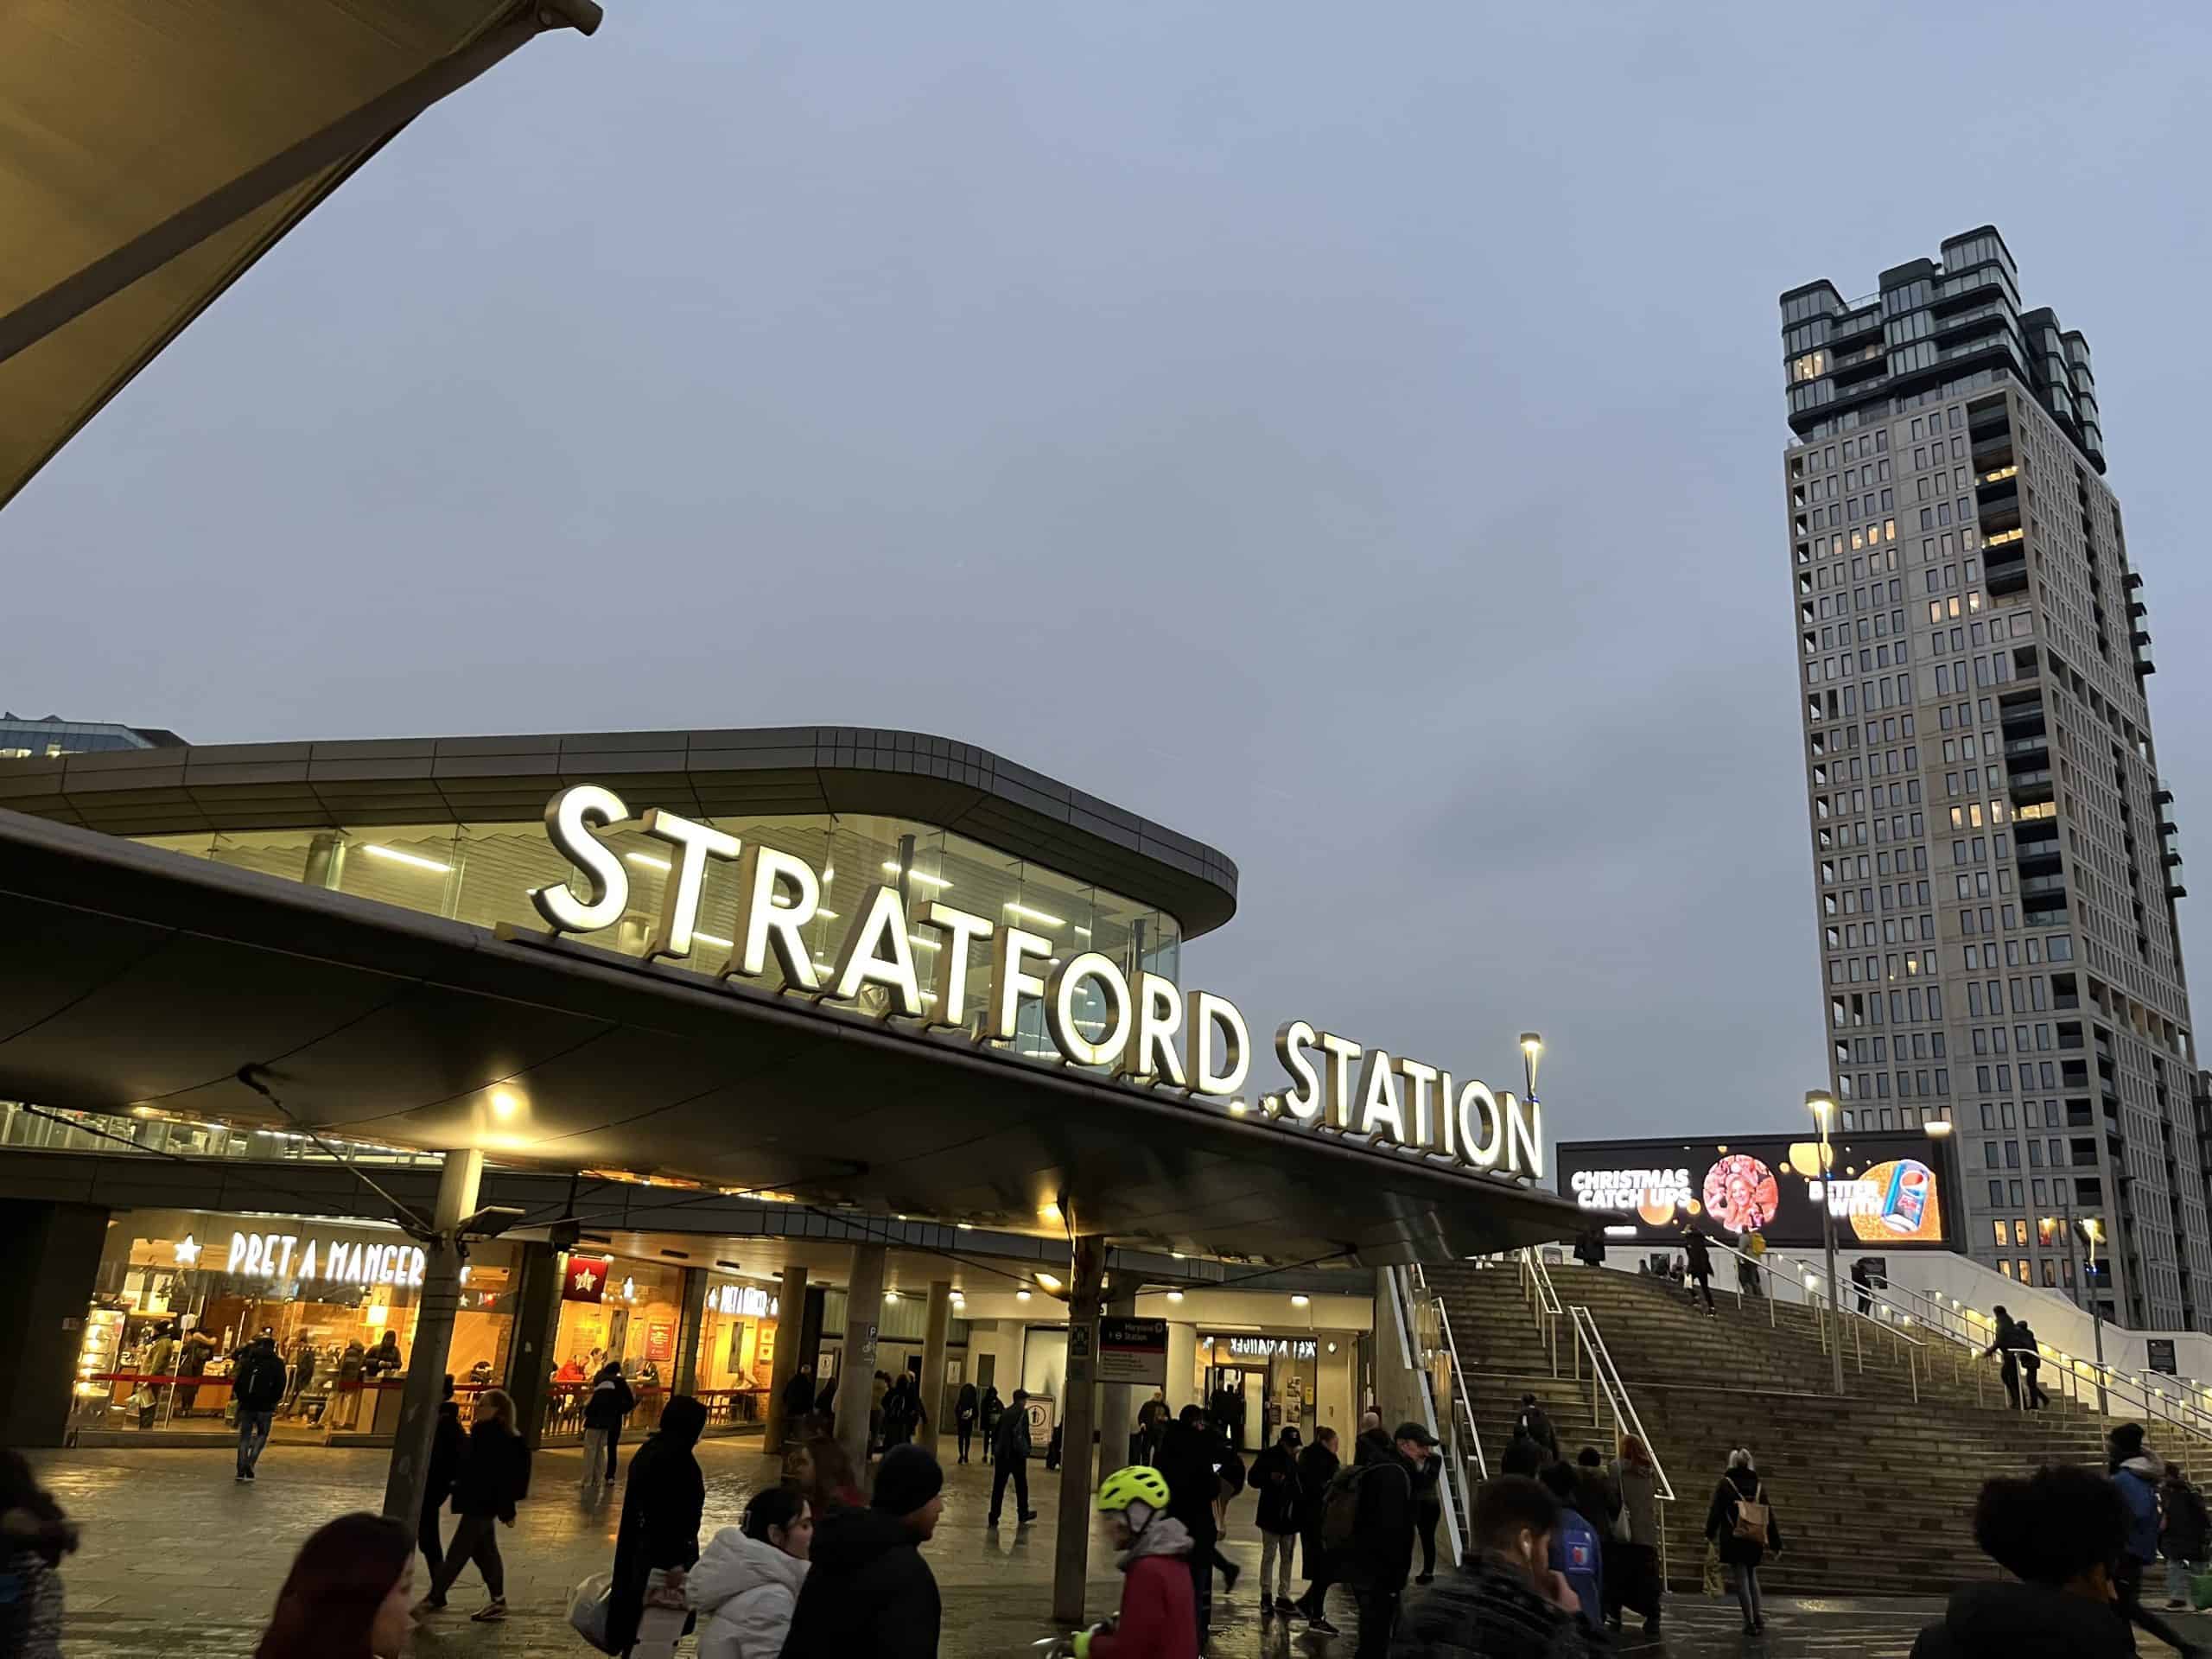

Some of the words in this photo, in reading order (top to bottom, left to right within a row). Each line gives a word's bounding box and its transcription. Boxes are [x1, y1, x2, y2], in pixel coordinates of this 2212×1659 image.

[529, 782, 1252, 1095] STRATFORD
[1276, 1020, 1543, 1179] STATION
[1571, 1169, 1689, 1191] CHRISTMAS
[1578, 1189, 1642, 1209] CATCH
[1649, 1187, 1693, 1208] UPS
[227, 1231, 296, 1275] PRET
[298, 1238, 316, 1278] A
[325, 1242, 425, 1285] MANGER
